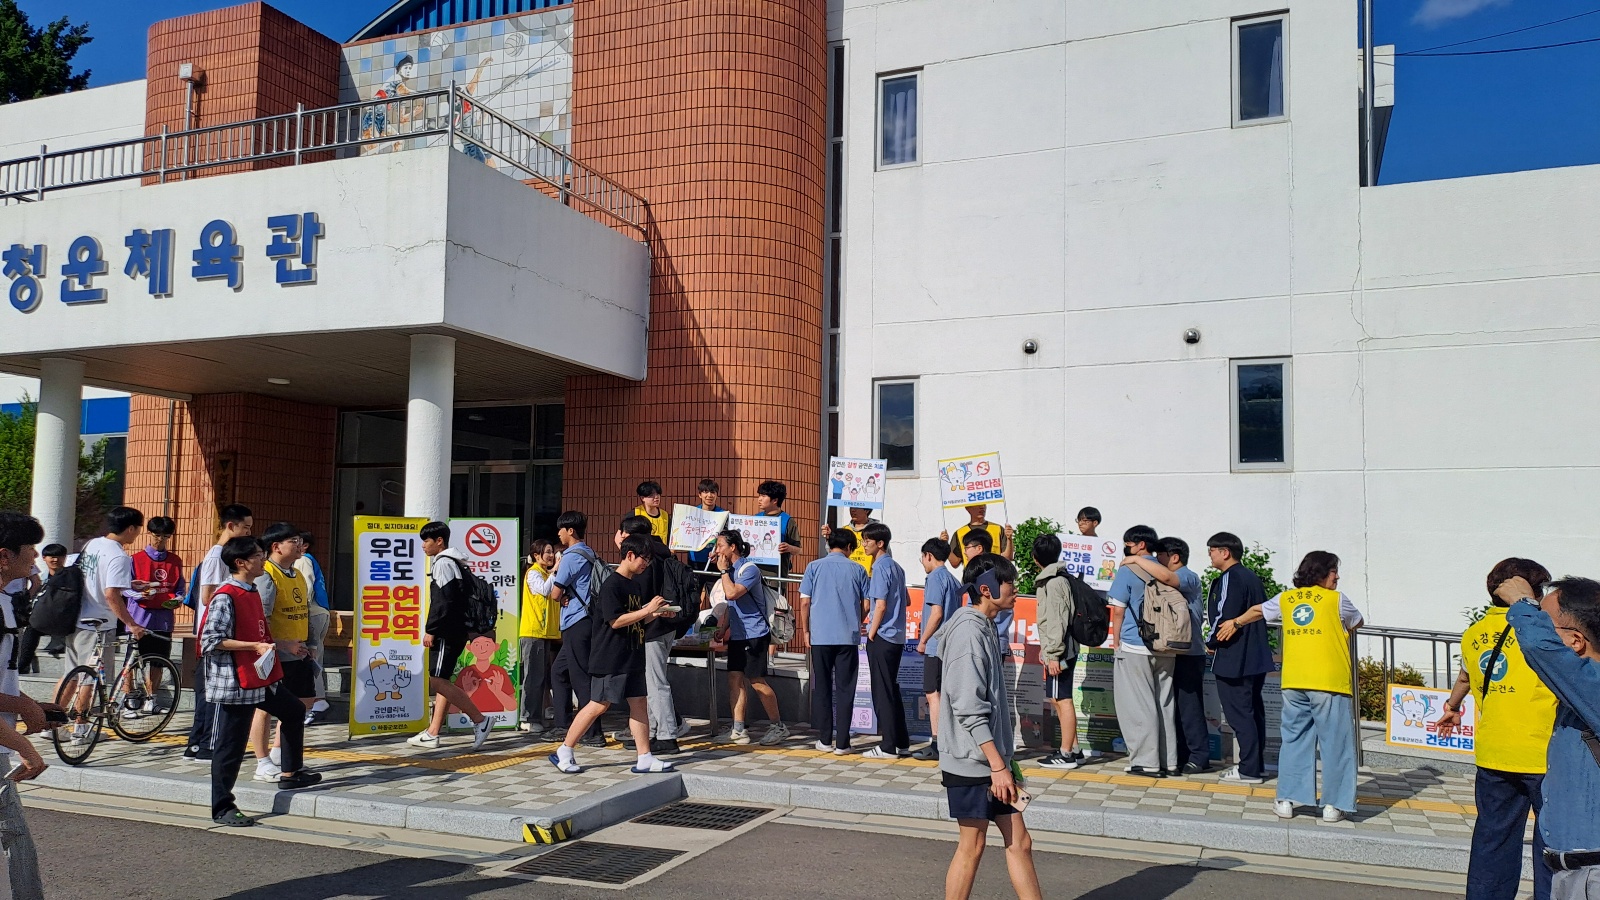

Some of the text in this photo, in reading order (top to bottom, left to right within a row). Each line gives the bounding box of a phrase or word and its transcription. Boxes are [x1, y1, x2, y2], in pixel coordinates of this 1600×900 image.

[3, 212, 324, 314] 청운체육관
[967, 478, 1002, 491] 금연다짐
[968, 489, 1003, 502] 건강다짐
[370, 538, 414, 558] 우리
[1063, 551, 1091, 563] 건강을
[370, 561, 414, 581] 몸도
[468, 561, 501, 573] 금연은
[362, 585, 420, 612] 금연
[1287, 590, 1324, 604] 건강증진
[361, 613, 420, 641] 구역
